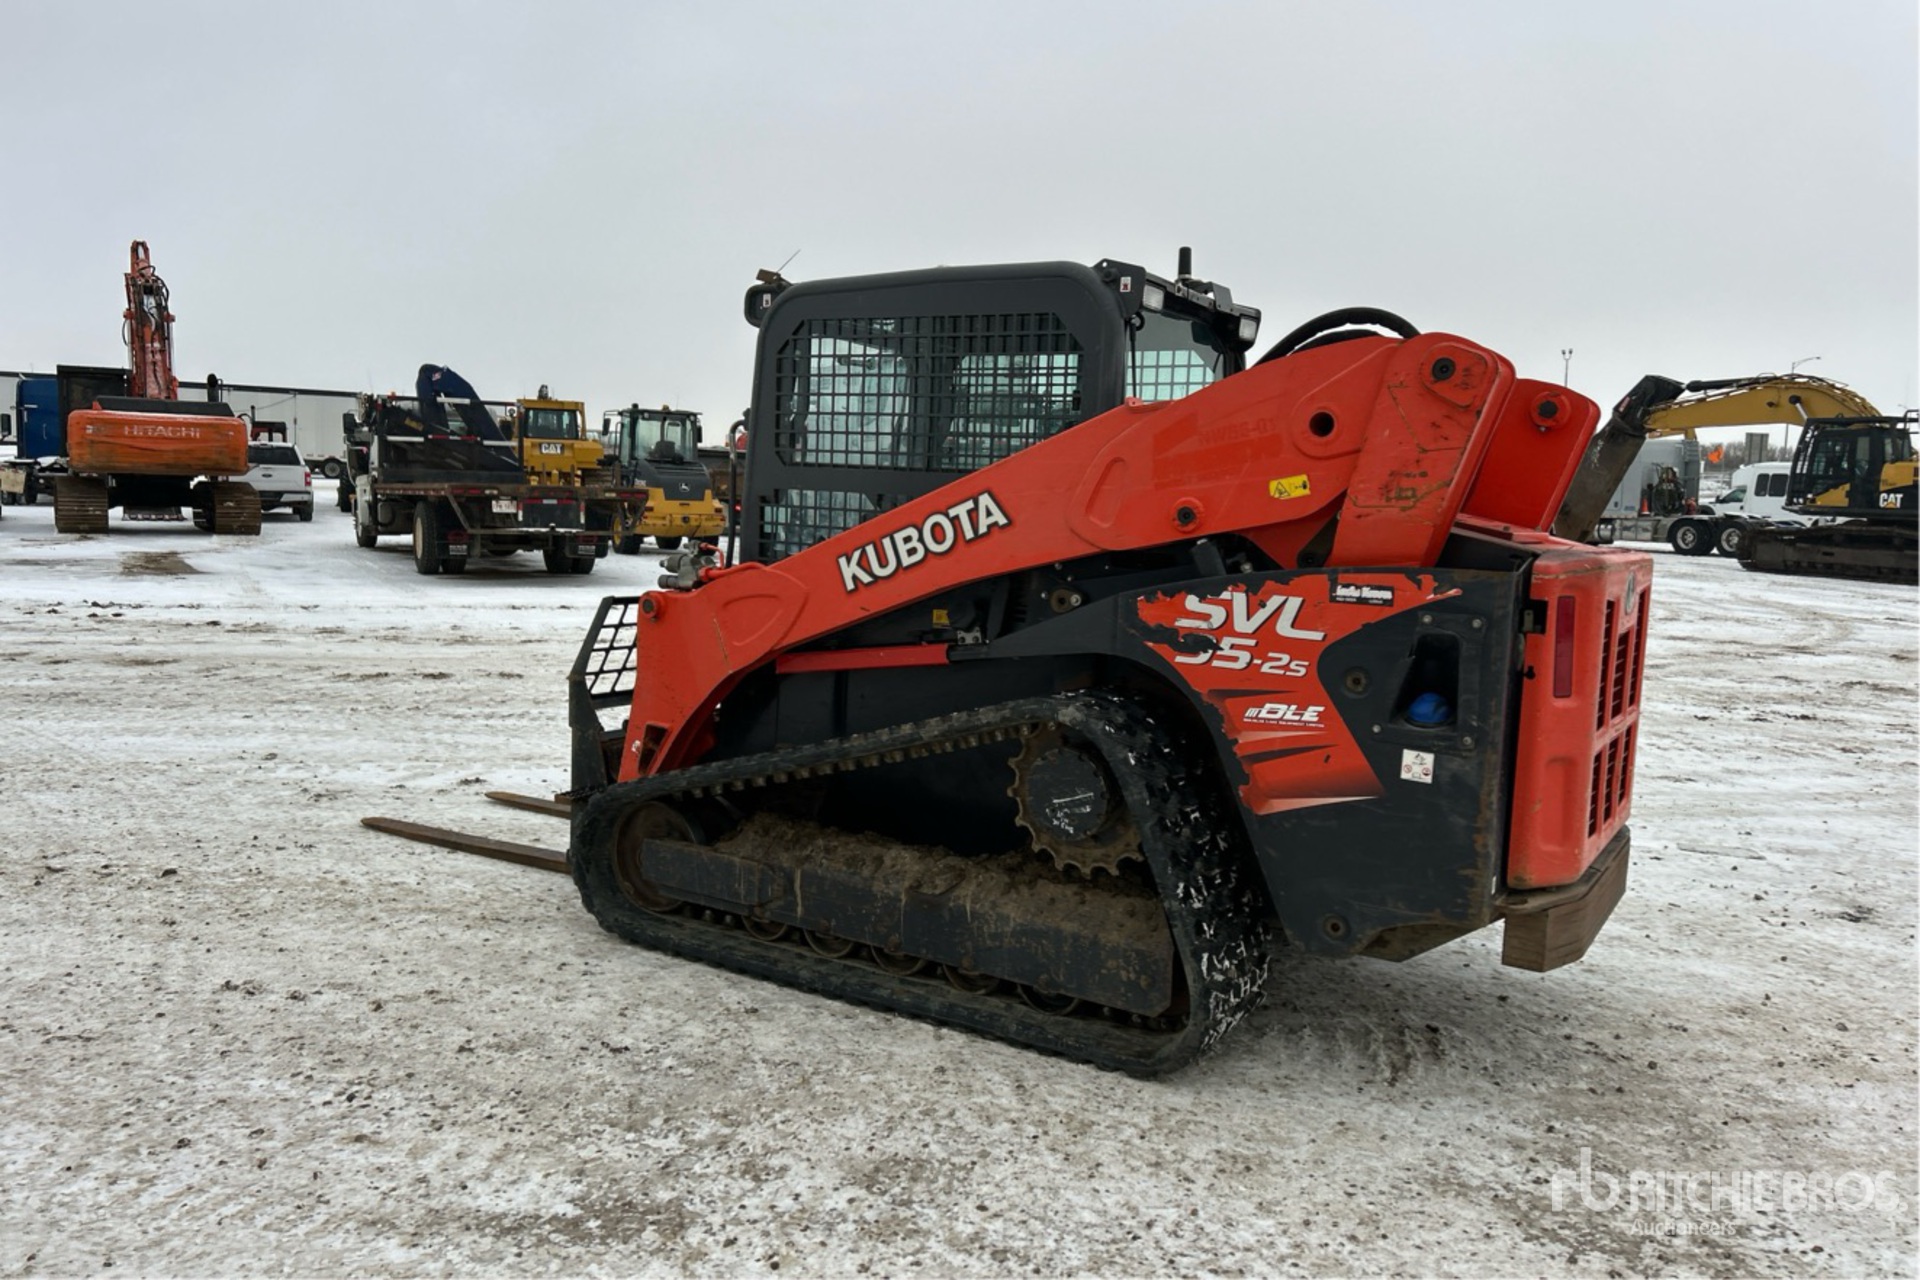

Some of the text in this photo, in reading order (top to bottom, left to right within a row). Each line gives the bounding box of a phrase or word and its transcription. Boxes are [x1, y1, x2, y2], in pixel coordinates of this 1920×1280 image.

[124, 424, 200, 439] HITACHI
[541, 442, 562, 455] CAT
[1879, 492, 1904, 508] CAT
[838, 491, 1009, 593] KUBOTA
[1174, 591, 1326, 641] SVL
